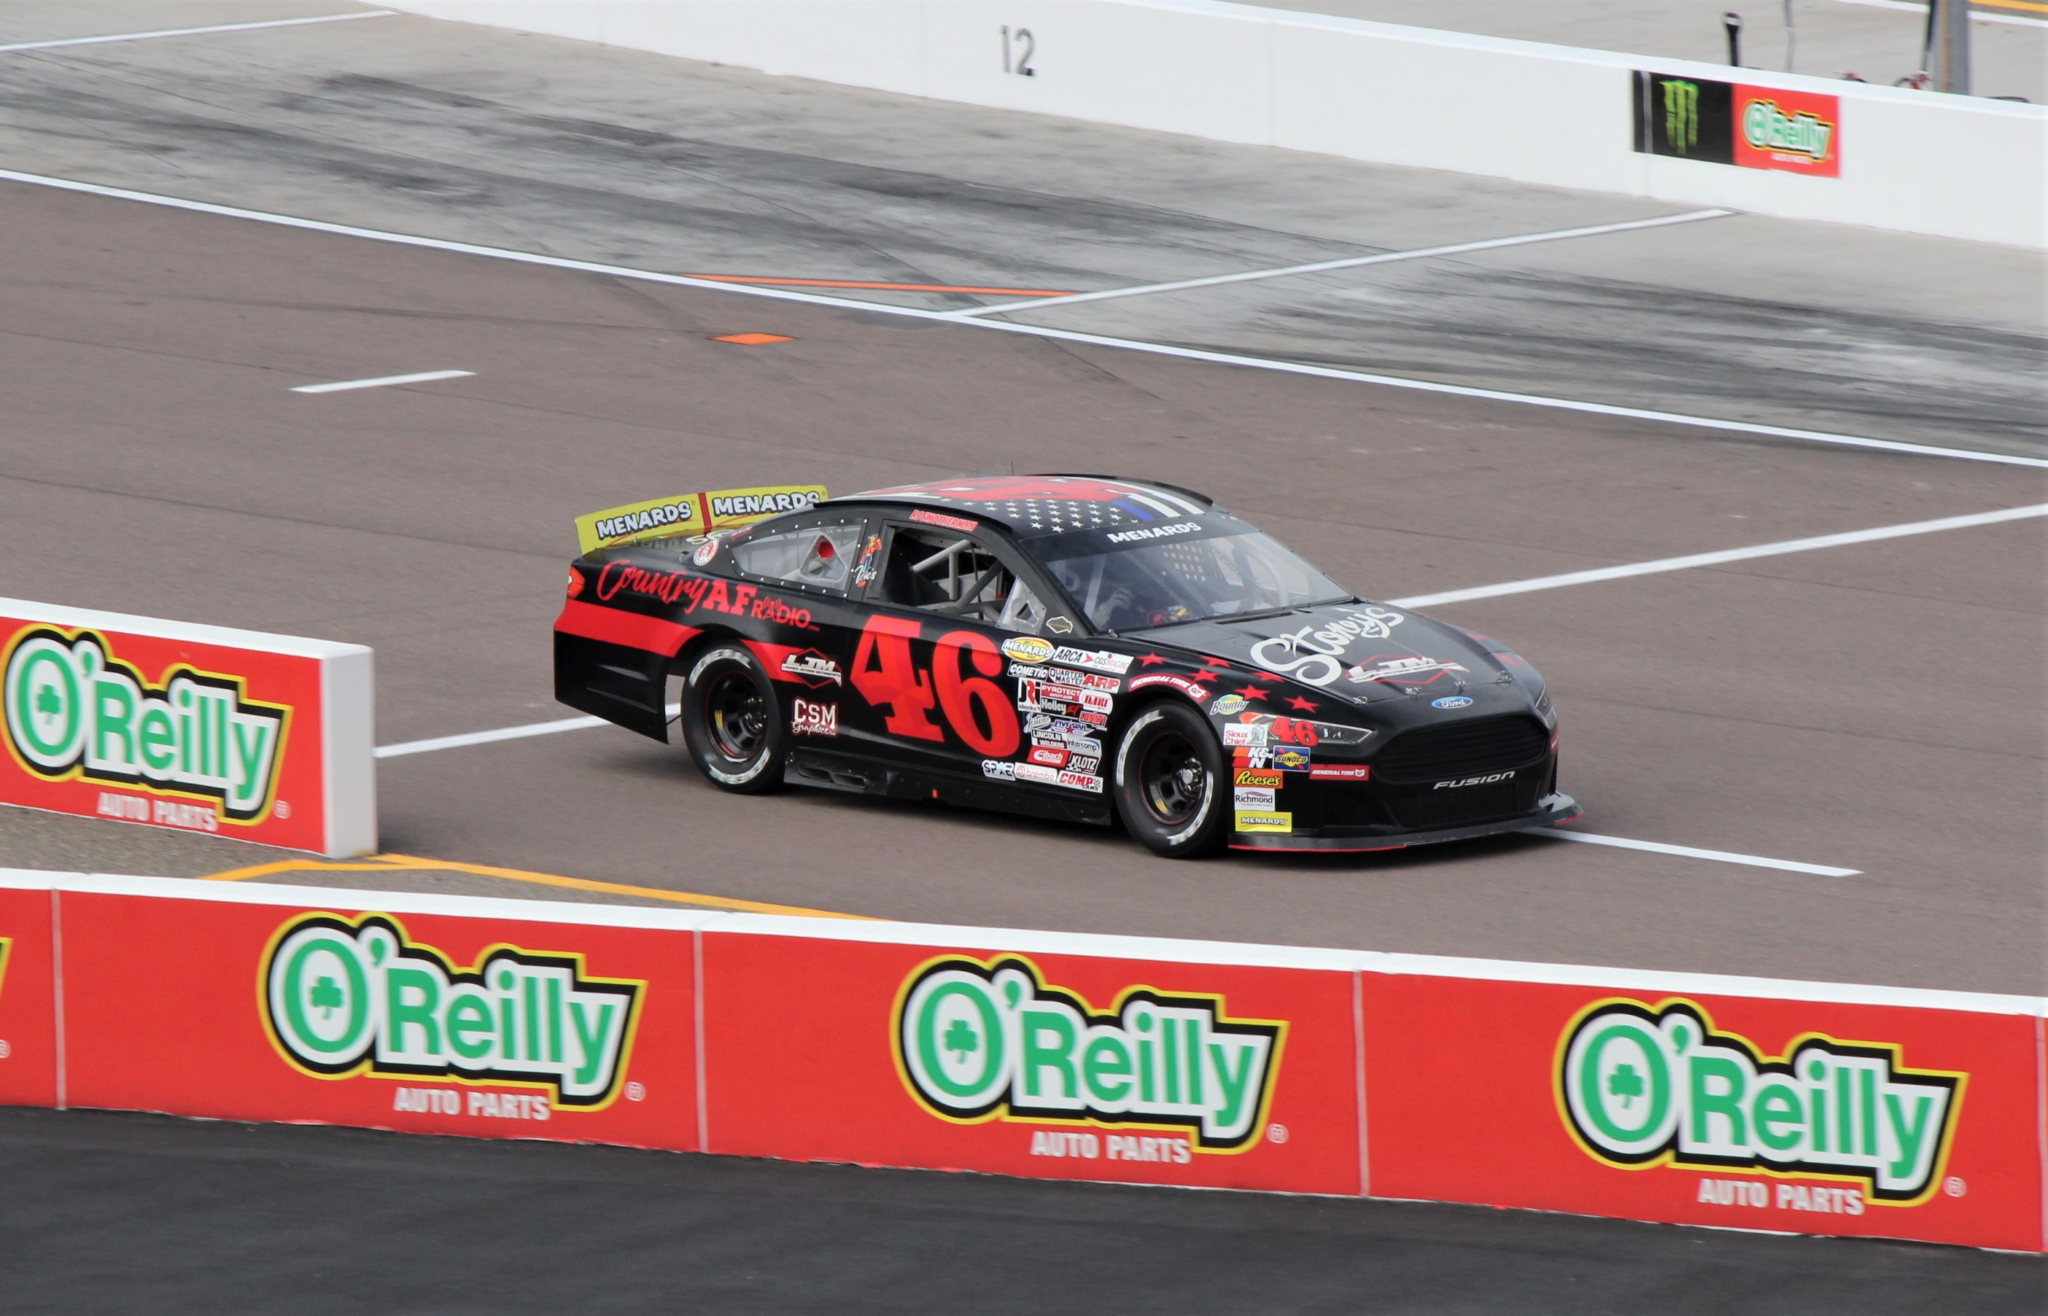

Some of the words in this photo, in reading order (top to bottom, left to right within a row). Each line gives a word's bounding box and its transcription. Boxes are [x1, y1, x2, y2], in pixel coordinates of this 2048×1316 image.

[999, 24, 1037, 77] 12
[1744, 102, 1830, 159] O'Reilly
[712, 491, 821, 516] MENARDS
[596, 501, 692, 539] MENARDS
[1106, 522, 1202, 543] MENARDS
[596, 559, 710, 614] Country
[702, 579, 758, 616] AF
[751, 597, 811, 628] RADIO
[1003, 640, 1054, 659] MENARDS
[1250, 607, 1405, 686] Stoney's
[785, 654, 836, 672] LJM
[1055, 648, 1083, 663] ARCA
[1009, 664, 1048, 679] COMETIC
[1049, 667, 1083, 679] QUARTER
[850, 614, 1020, 758] 46
[1041, 684, 1081, 697] PYROTECT
[1083, 675, 1120, 690] ARP
[1131, 675, 1171, 688] GENERAL
[1170, 677, 1192, 689] TIRE
[1041, 698, 1067, 715] Holley
[1210, 700, 1249, 715] Bounty
[1441, 699, 1467, 708] Ford
[793, 698, 836, 729] CSM
[12, 642, 275, 806] O'Reilly
[1271, 716, 1318, 746] 46
[1032, 730, 1062, 741] LINCOLN
[1225, 729, 1248, 738] Sioux
[1225, 737, 1248, 745] Chief
[1067, 739, 1097, 752] intercomp
[1033, 749, 1063, 761] Eibach
[1071, 755, 1098, 771] KLOTZ
[1275, 755, 1309, 763] SUNOCO
[1026, 769, 1054, 780] brembo
[1060, 773, 1094, 787] COMP
[1235, 770, 1280, 786] Reese's
[1433, 770, 1515, 790] FUSION
[1235, 793, 1273, 803] Richmond
[97, 792, 149, 821] AUTO
[153, 799, 218, 832] PARTS
[1241, 816, 1286, 825] MENARDS
[280, 932, 622, 1091] O'Reilly
[910, 974, 1264, 1133] O'Reilly
[394, 1086, 460, 1116] AUTO
[468, 1090, 550, 1121] PARTS
[1573, 1018, 1941, 1185] O'Reilly
[1031, 1130, 1099, 1160] AUTO
[1107, 1135, 1192, 1165] PARTS
[1697, 1177, 1768, 1209] AUTO
[1776, 1182, 1865, 1216] PARTS
